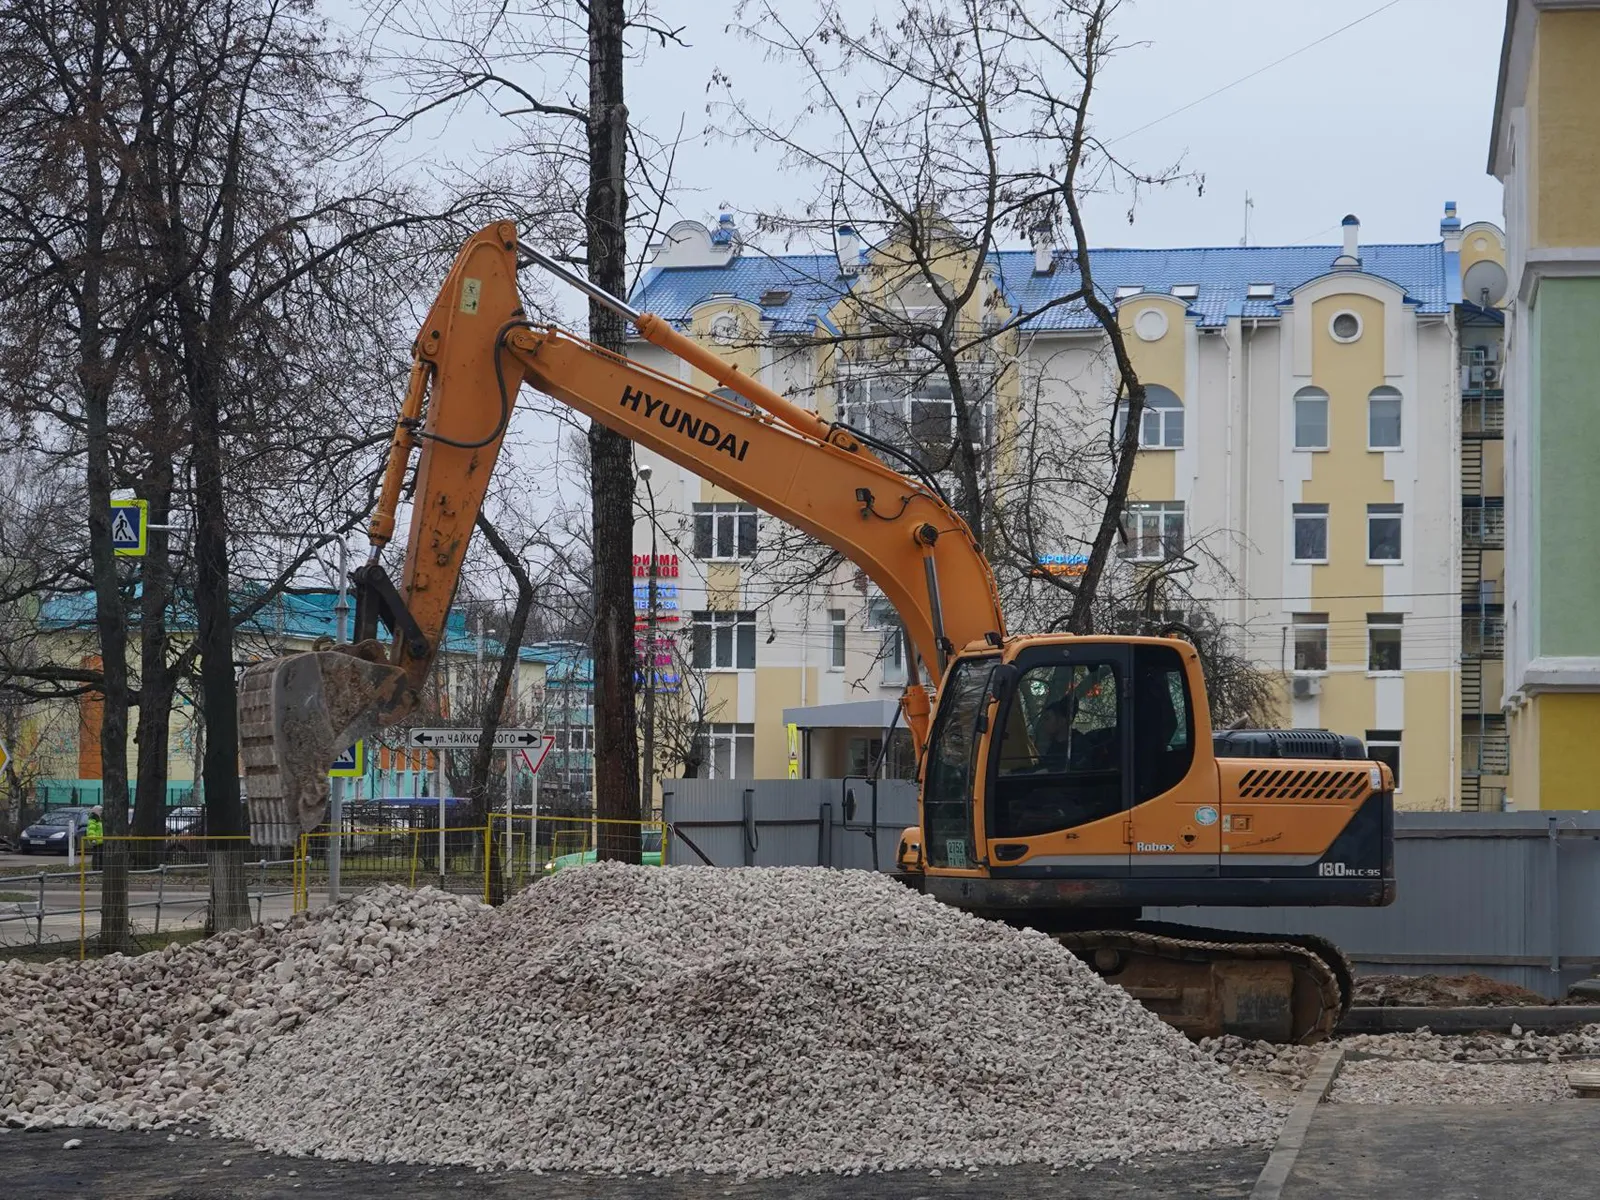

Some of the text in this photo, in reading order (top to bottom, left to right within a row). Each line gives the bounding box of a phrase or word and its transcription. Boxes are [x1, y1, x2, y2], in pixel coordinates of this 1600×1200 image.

[620, 385, 749, 462] HYUNDAI
[434, 732, 515, 745] ул. ЧАЙКООГО
